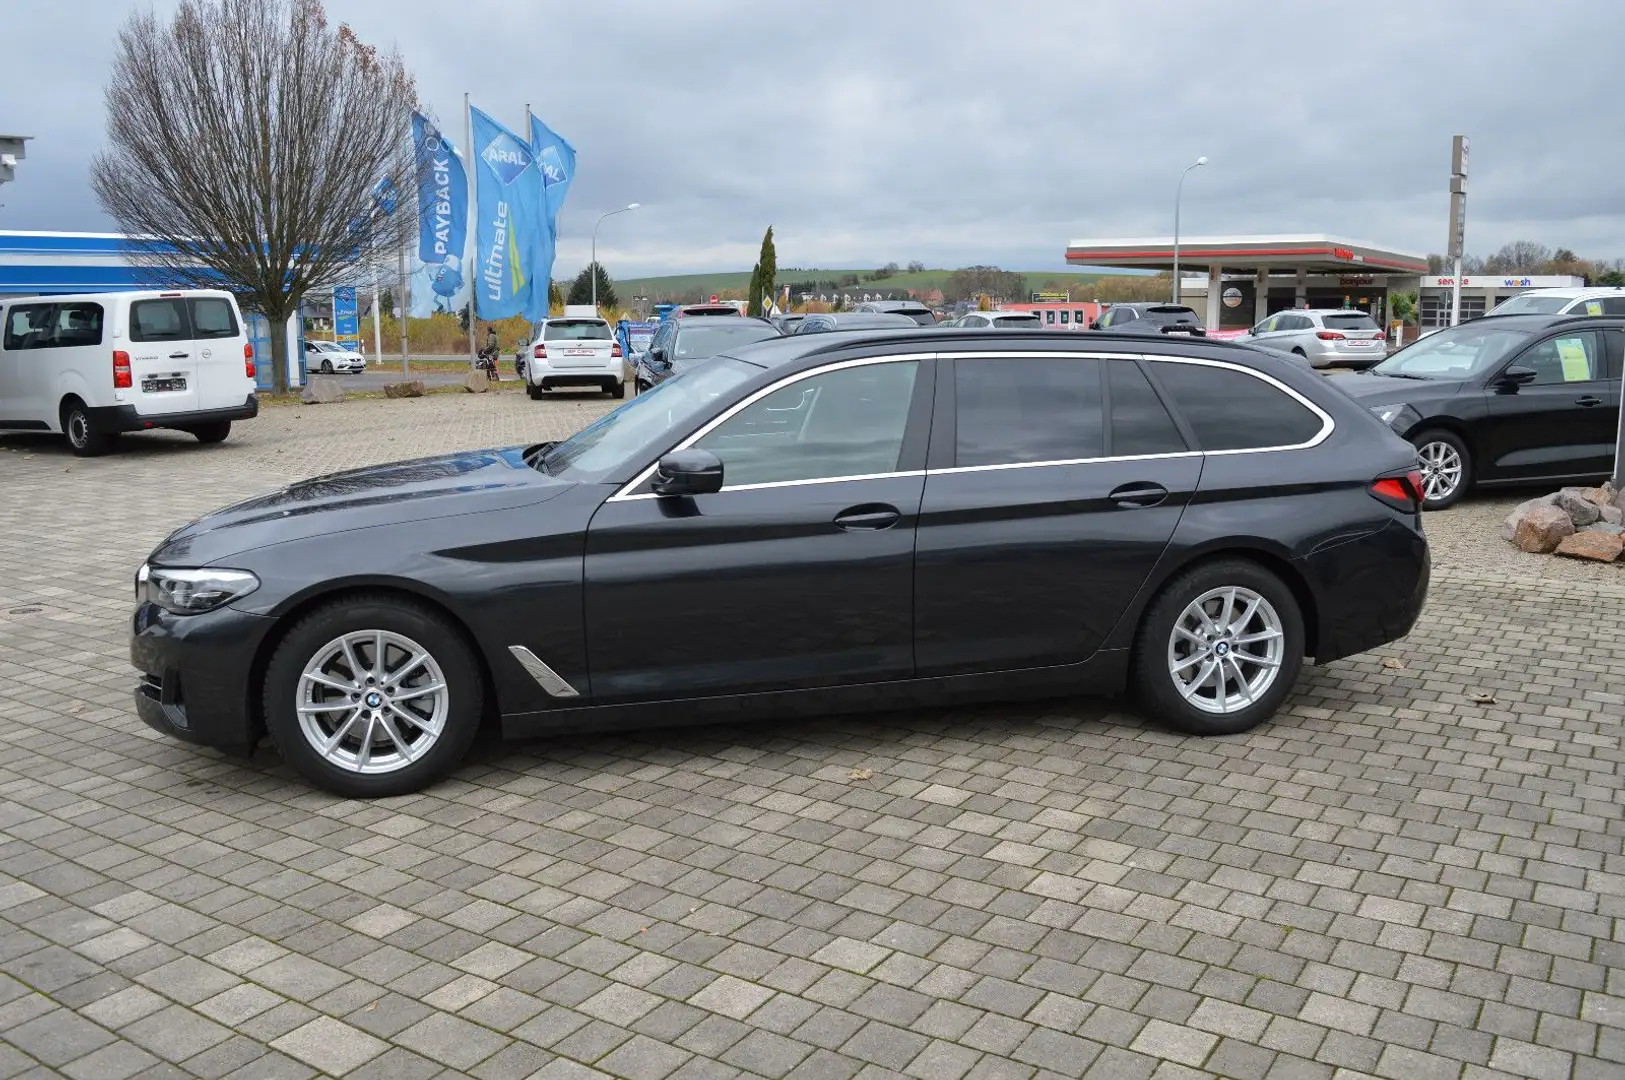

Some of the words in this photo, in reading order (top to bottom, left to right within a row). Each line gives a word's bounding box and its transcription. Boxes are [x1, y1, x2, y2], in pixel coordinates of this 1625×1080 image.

[488, 151, 527, 167] ARAL
[434, 158, 451, 255] PAYBACK
[484, 200, 508, 301] ultimate
[1437, 277, 1469, 287] serve
[1504, 277, 1531, 287] wash
